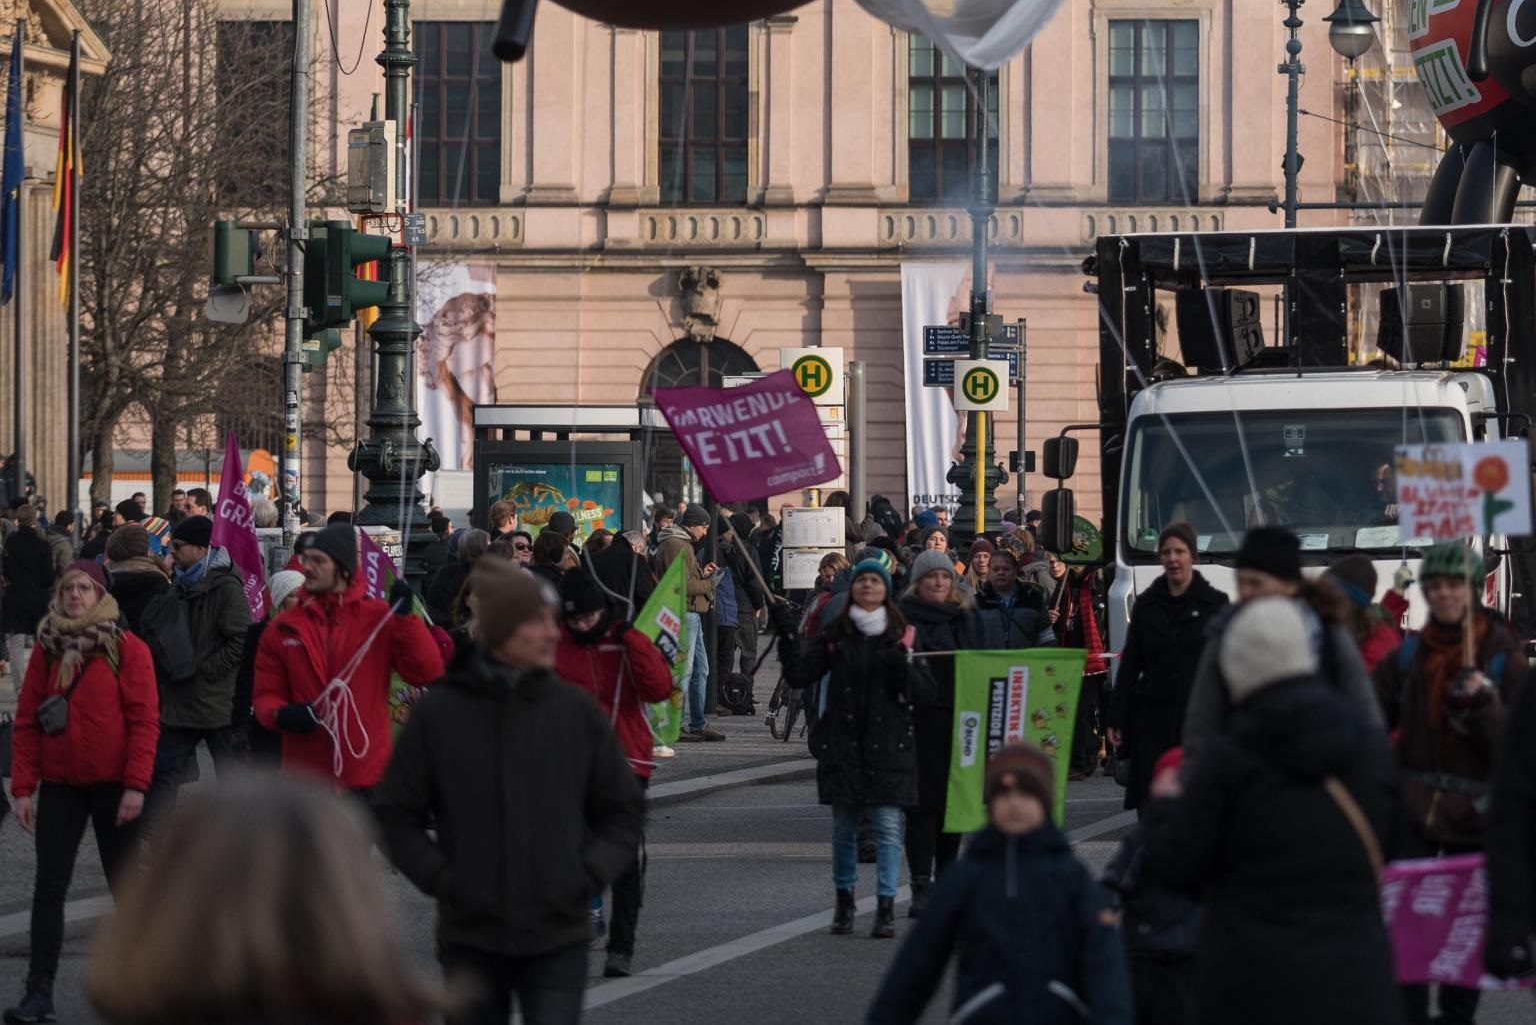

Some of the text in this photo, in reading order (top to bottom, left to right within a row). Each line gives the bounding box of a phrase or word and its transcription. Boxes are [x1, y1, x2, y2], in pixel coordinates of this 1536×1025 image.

[802, 364, 821, 387] H
[972, 375, 989, 395] H
[989, 681, 1006, 741] PESTIZIDE
[1009, 670, 1024, 731] INSEKTEN
[964, 729, 974, 757] BUND
